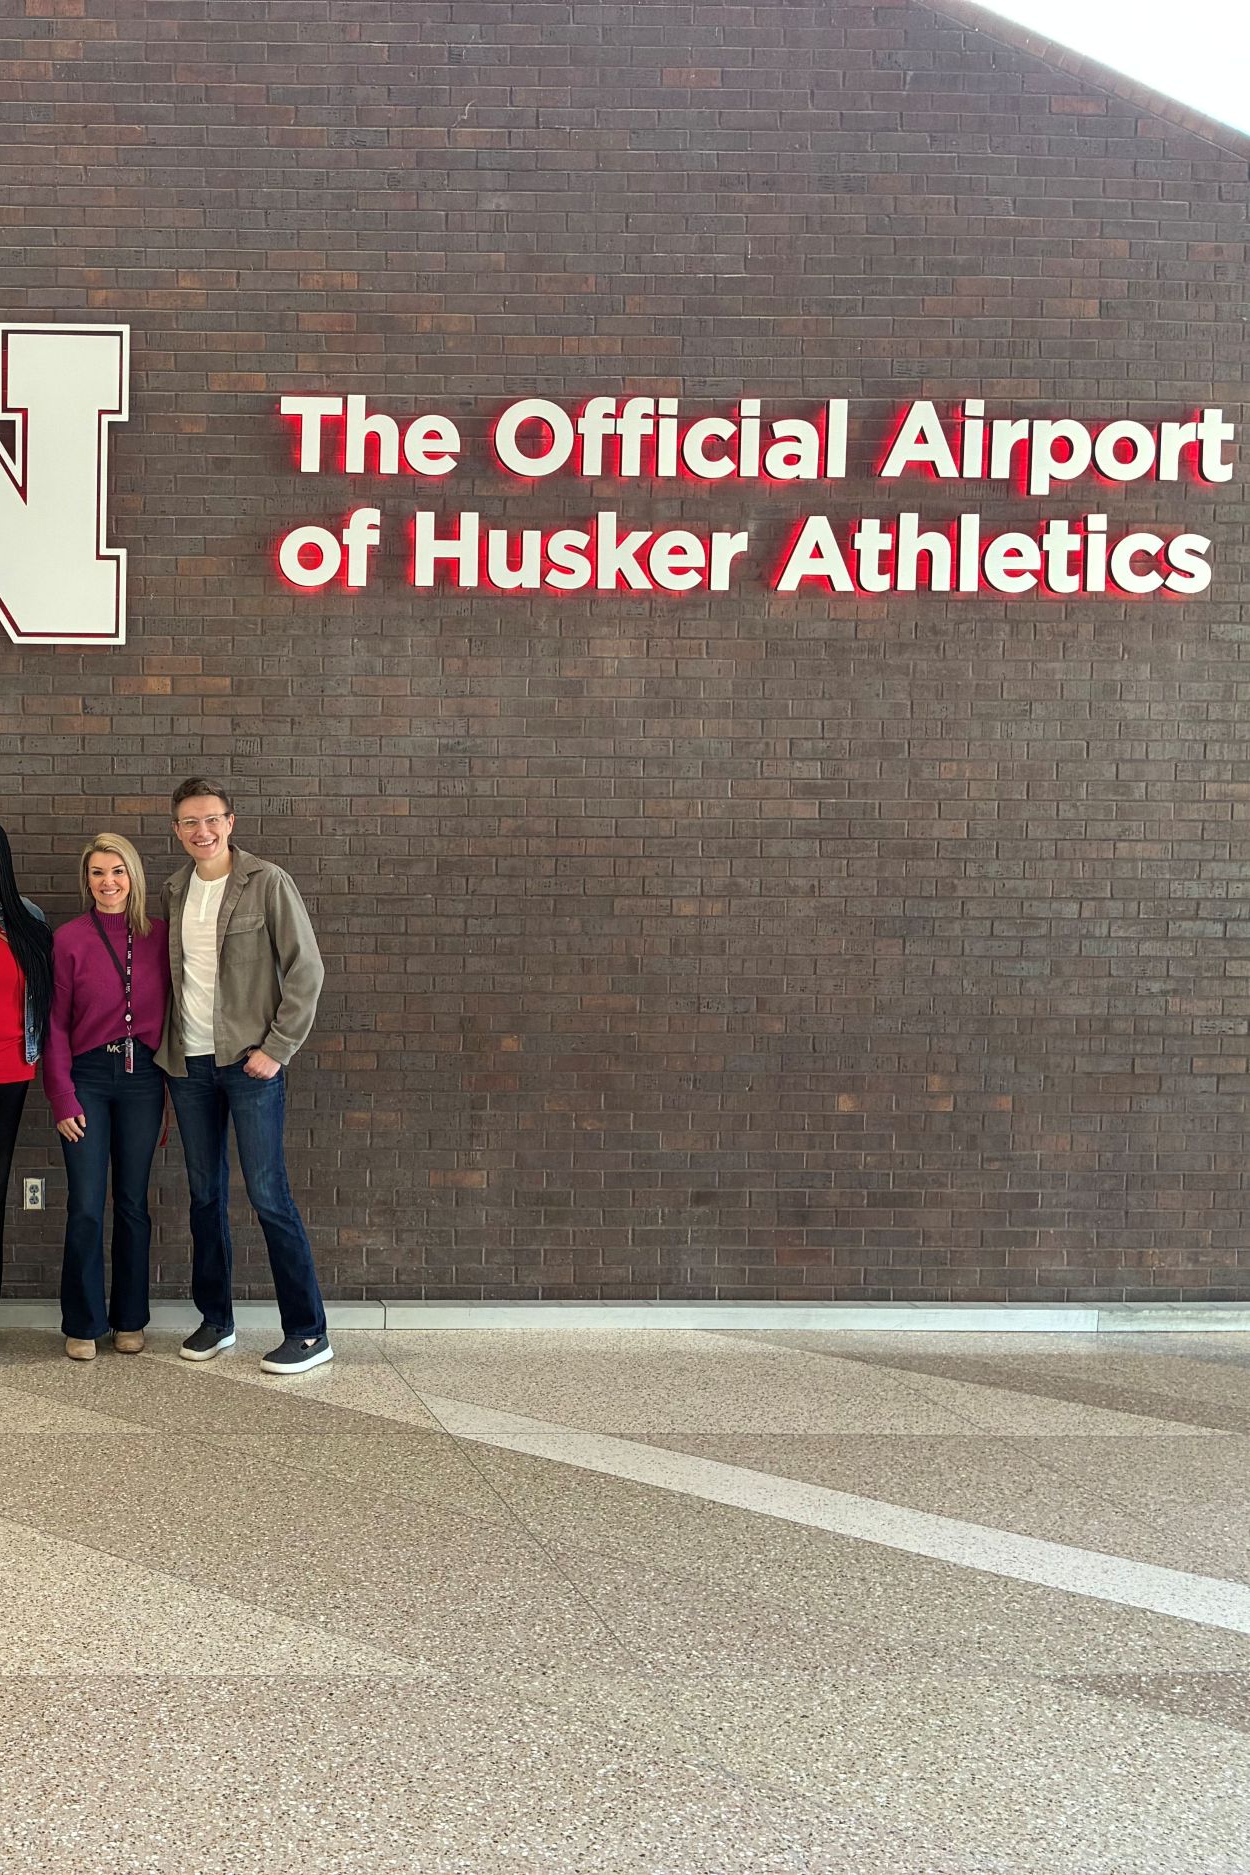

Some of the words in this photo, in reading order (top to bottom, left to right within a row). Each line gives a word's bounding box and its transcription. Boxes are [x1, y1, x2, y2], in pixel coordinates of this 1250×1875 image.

[280, 395, 461, 477] The
[495, 397, 849, 479] Official
[880, 398, 1235, 496] Airport
[279, 508, 381, 588] of
[414, 511, 749, 592] Husker
[776, 513, 1212, 594] Athletics
